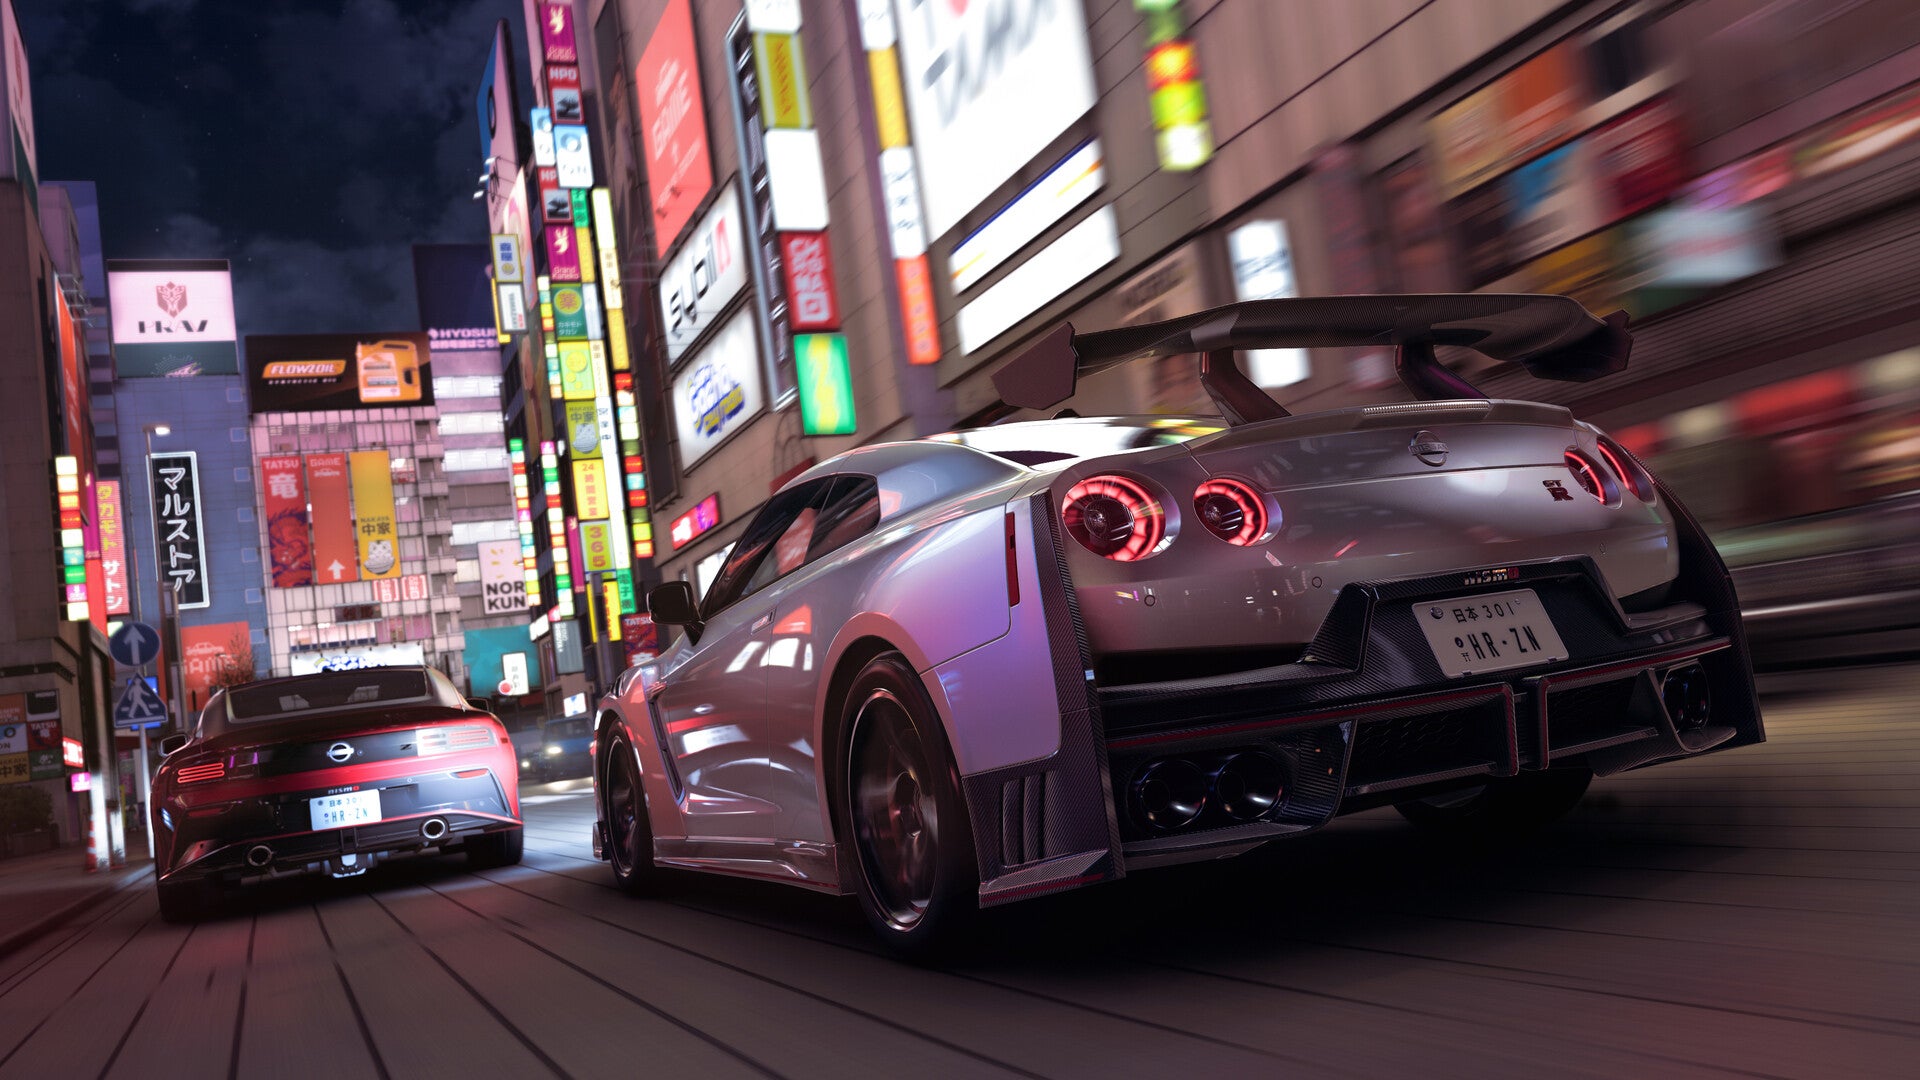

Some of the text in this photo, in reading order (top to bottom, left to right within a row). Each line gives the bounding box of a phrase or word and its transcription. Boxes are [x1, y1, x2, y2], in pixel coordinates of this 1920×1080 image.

[264, 459, 299, 470] TATSU
[310, 457, 341, 467] GAME
[268, 472, 298, 499] 竜
[159, 467, 196, 592] マルストア
[361, 522, 391, 537] 中家
[102, 560, 123, 611] サトシ
[486, 581, 525, 596] NOR
[488, 595, 527, 611] KUN
[1452, 601, 1515, 624] 日本 301
